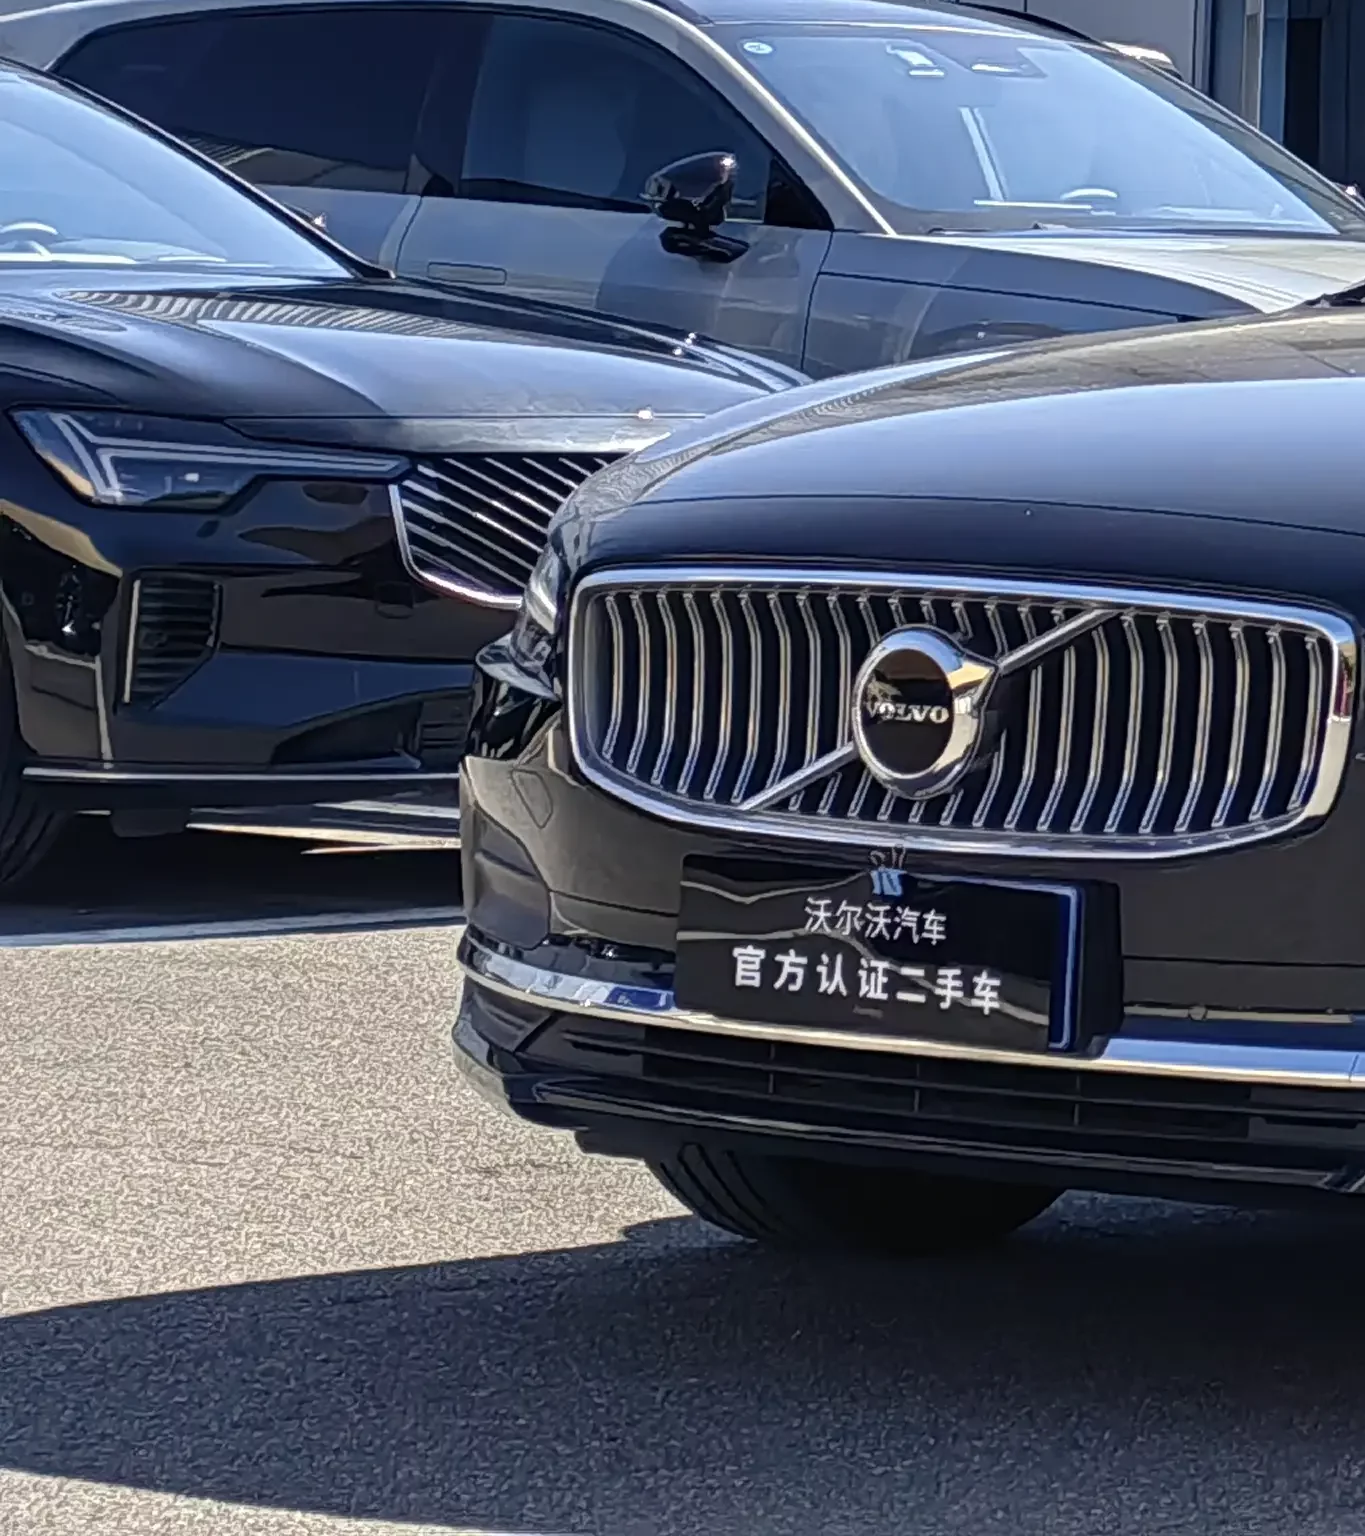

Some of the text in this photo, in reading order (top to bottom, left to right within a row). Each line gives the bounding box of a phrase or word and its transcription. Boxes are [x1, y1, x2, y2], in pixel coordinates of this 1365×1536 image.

[866, 701, 950, 724] VOLVO
[803, 896, 948, 946] 沃尔沃汽车
[732, 944, 1001, 1017] 官方认证二手车
